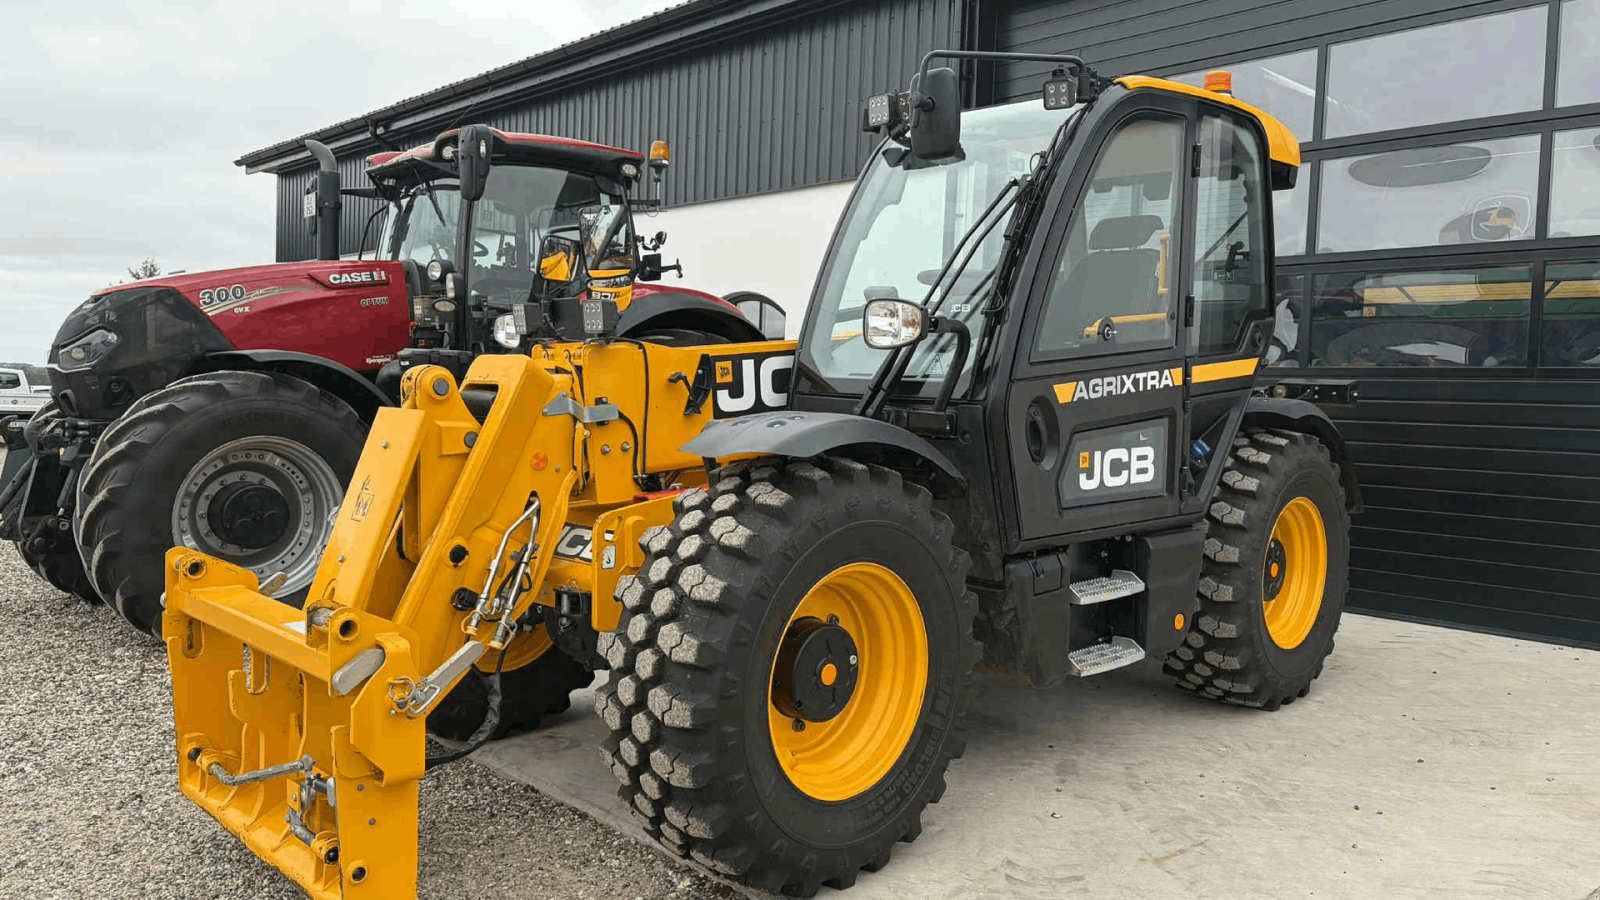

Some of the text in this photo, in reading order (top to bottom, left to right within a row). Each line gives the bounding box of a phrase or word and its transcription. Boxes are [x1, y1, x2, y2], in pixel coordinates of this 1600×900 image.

[328, 272, 370, 285] CASE
[199, 284, 246, 307] 300
[360, 296, 388, 308] OPTUM
[234, 305, 250, 314] CVX
[716, 355, 795, 412] JC
[1073, 369, 1174, 402] AGRIXTRA
[1079, 446, 1155, 490] JCB
